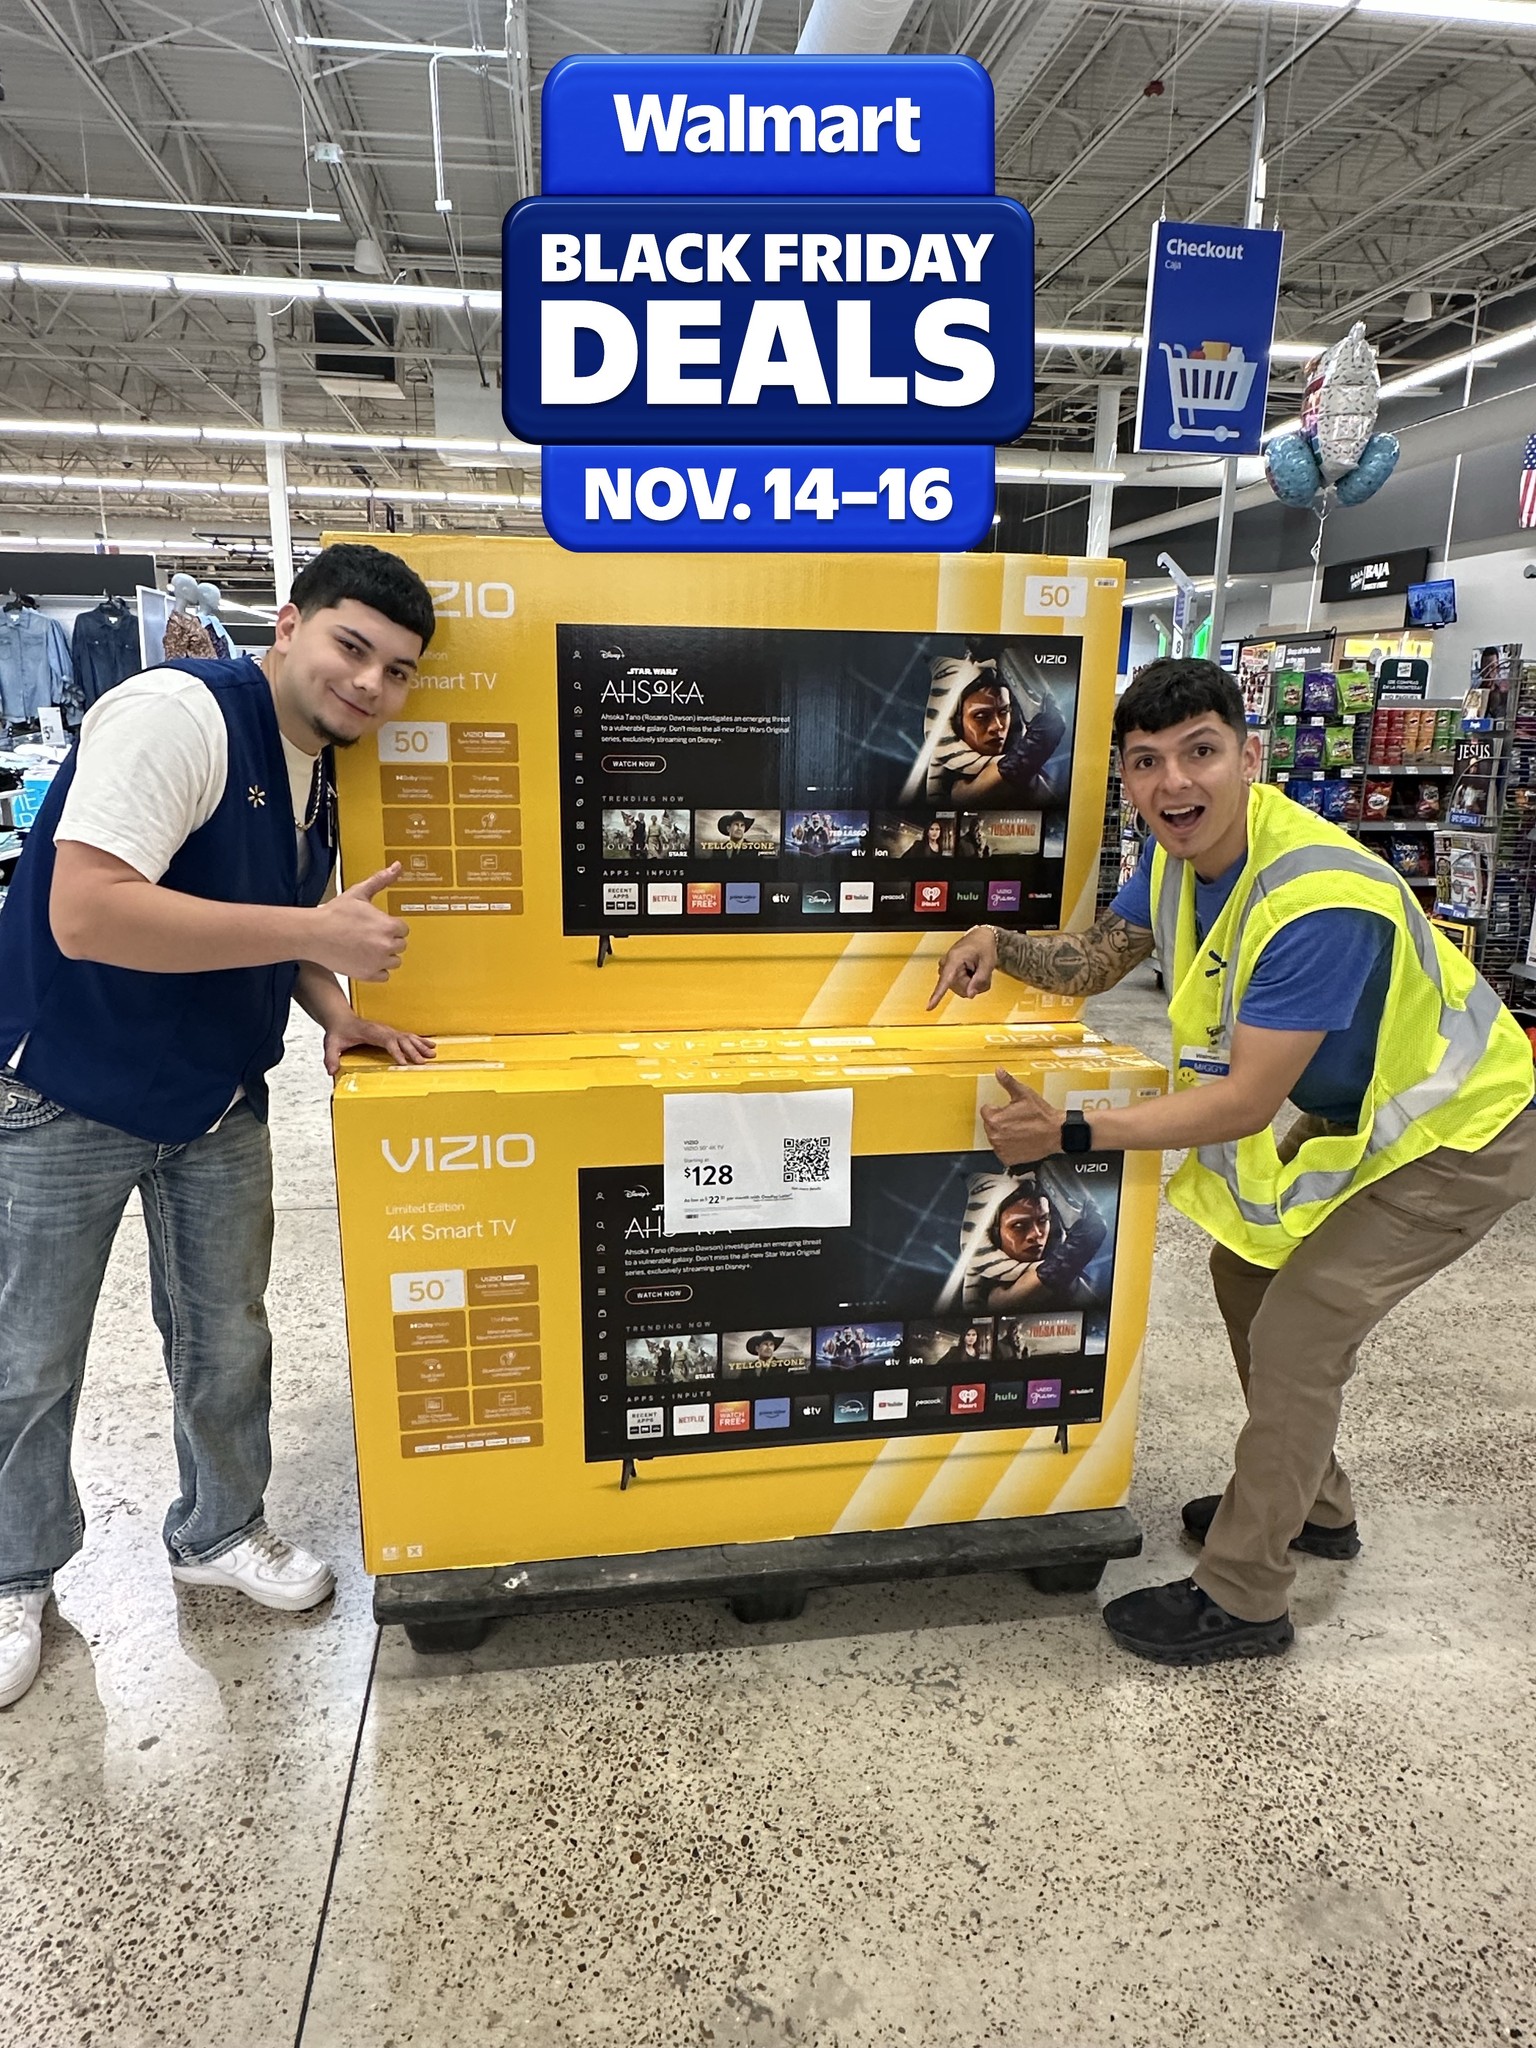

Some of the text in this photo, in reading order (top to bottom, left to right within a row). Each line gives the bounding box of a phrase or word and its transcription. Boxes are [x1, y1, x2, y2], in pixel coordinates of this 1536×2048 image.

[1166, 238, 1244, 260] Checkout
[1164, 260, 1182, 270] Caja
[1365, 562, 1390, 579] BAJA
[425, 581, 515, 618] ZIO
[1034, 654, 1068, 664] VIZIO
[470, 672, 497, 690] TV
[600, 680, 704, 704] AHSOKA
[697, 715, 733, 723] investigates
[1458, 744, 1490, 760] JESUS
[957, 892, 978, 900] hulu
[382, 1134, 535, 1173] VIZIO
[1075, 1163, 1108, 1173] VIZIO
[684, 1165, 733, 1186] $128
[386, 1203, 464, 1215] Limited Edition
[388, 1219, 516, 1242] 4K Smart TV
[626, 1323, 682, 1332] TRENDING
[728, 1358, 805, 1370] YELLOWSTONE
[910, 1356, 923, 1364] ion
[672, 1391, 712, 1399] INPUTS
[995, 1392, 1018, 1401] hulu
[915, 1398, 941, 1408] peacock
